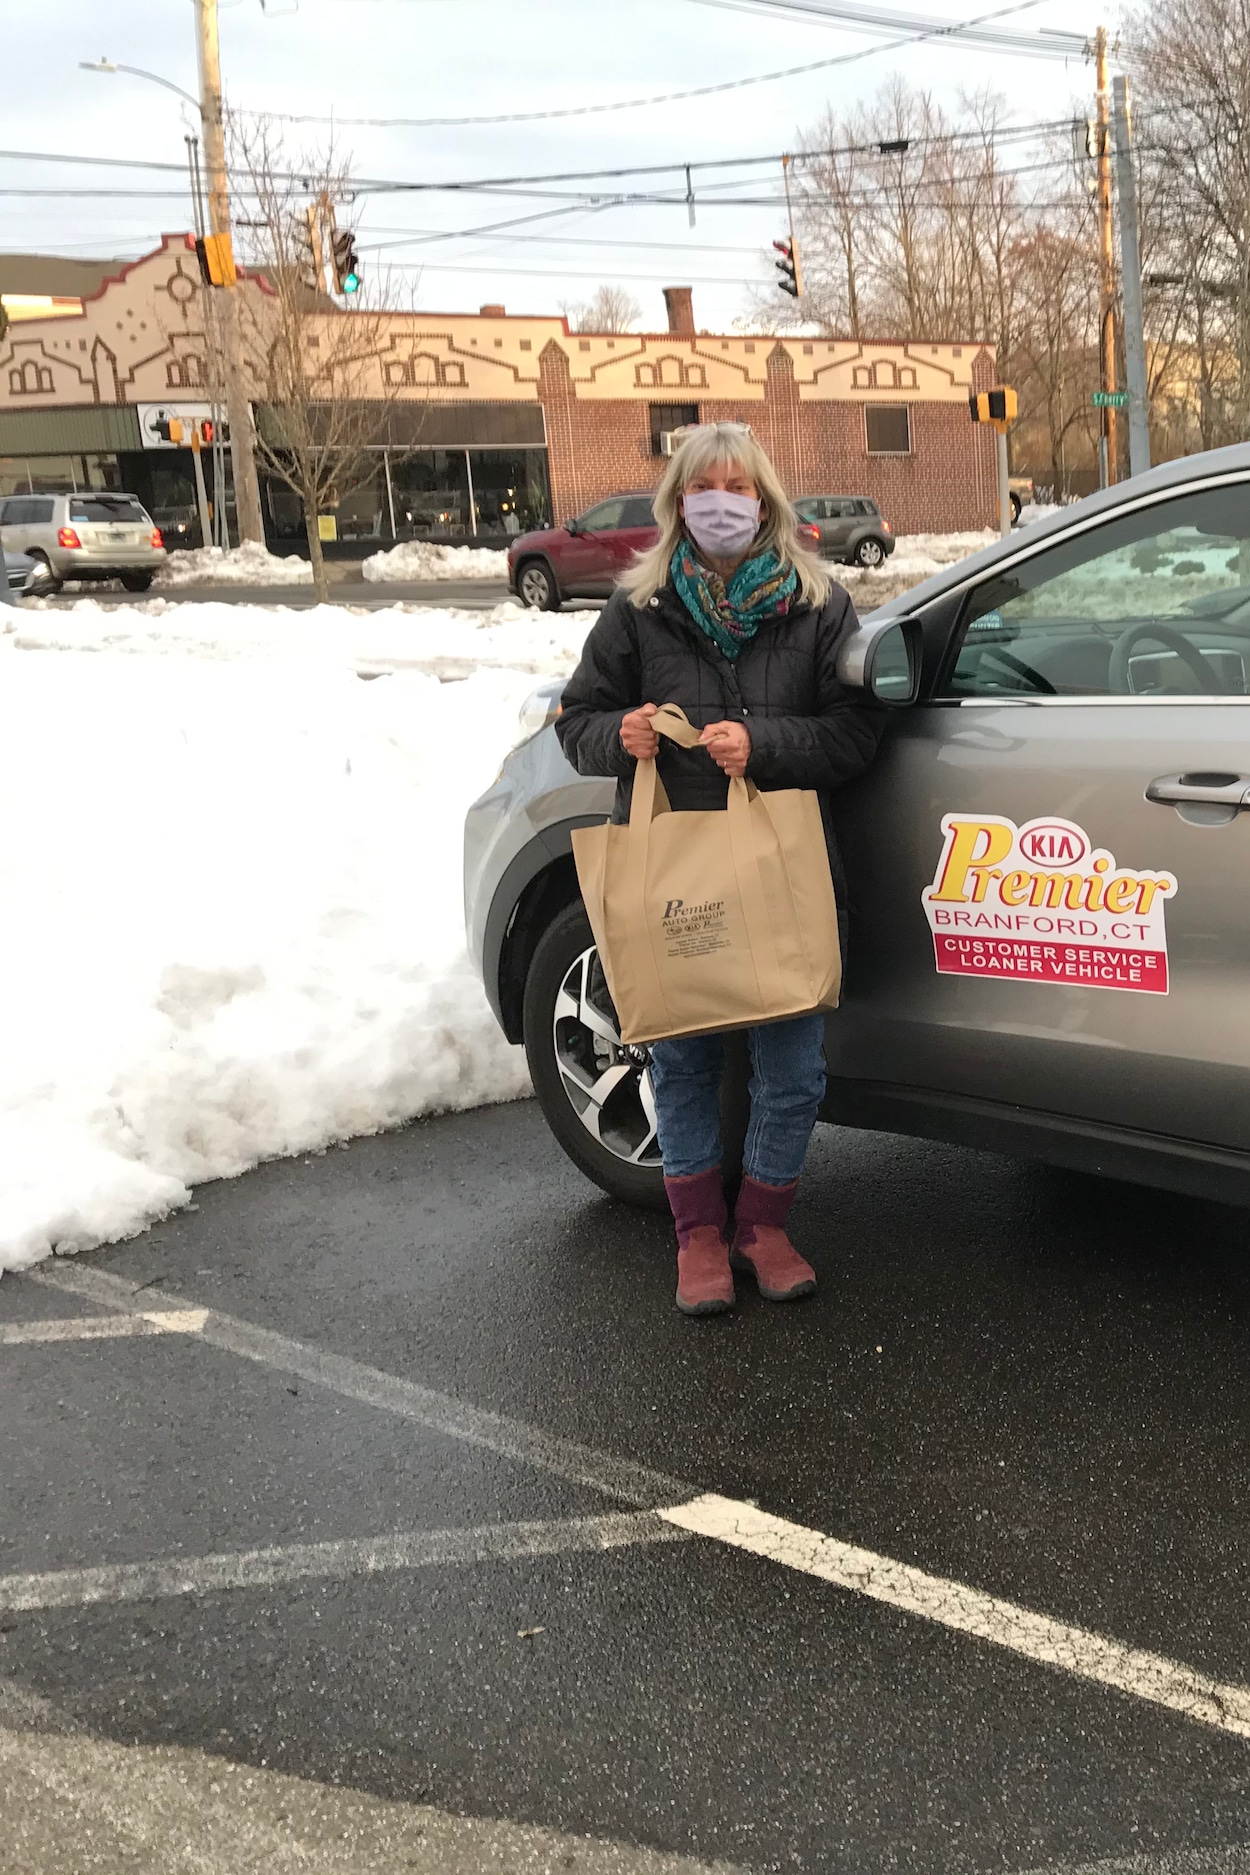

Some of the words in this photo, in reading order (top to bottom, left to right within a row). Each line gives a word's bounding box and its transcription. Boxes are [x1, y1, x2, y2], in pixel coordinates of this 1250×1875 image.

[1030, 834, 1074, 859] KIA
[928, 821, 1171, 915] Premier
[661, 899, 724, 919] Premier
[662, 917, 688, 927] AUTO
[691, 911, 725, 921] GROUP
[944, 938, 1057, 960] CUSTOMER
[1064, 948, 1158, 969] SERVICE
[960, 954, 1044, 973] LOANER
[1051, 962, 1142, 983] VEHICLE
